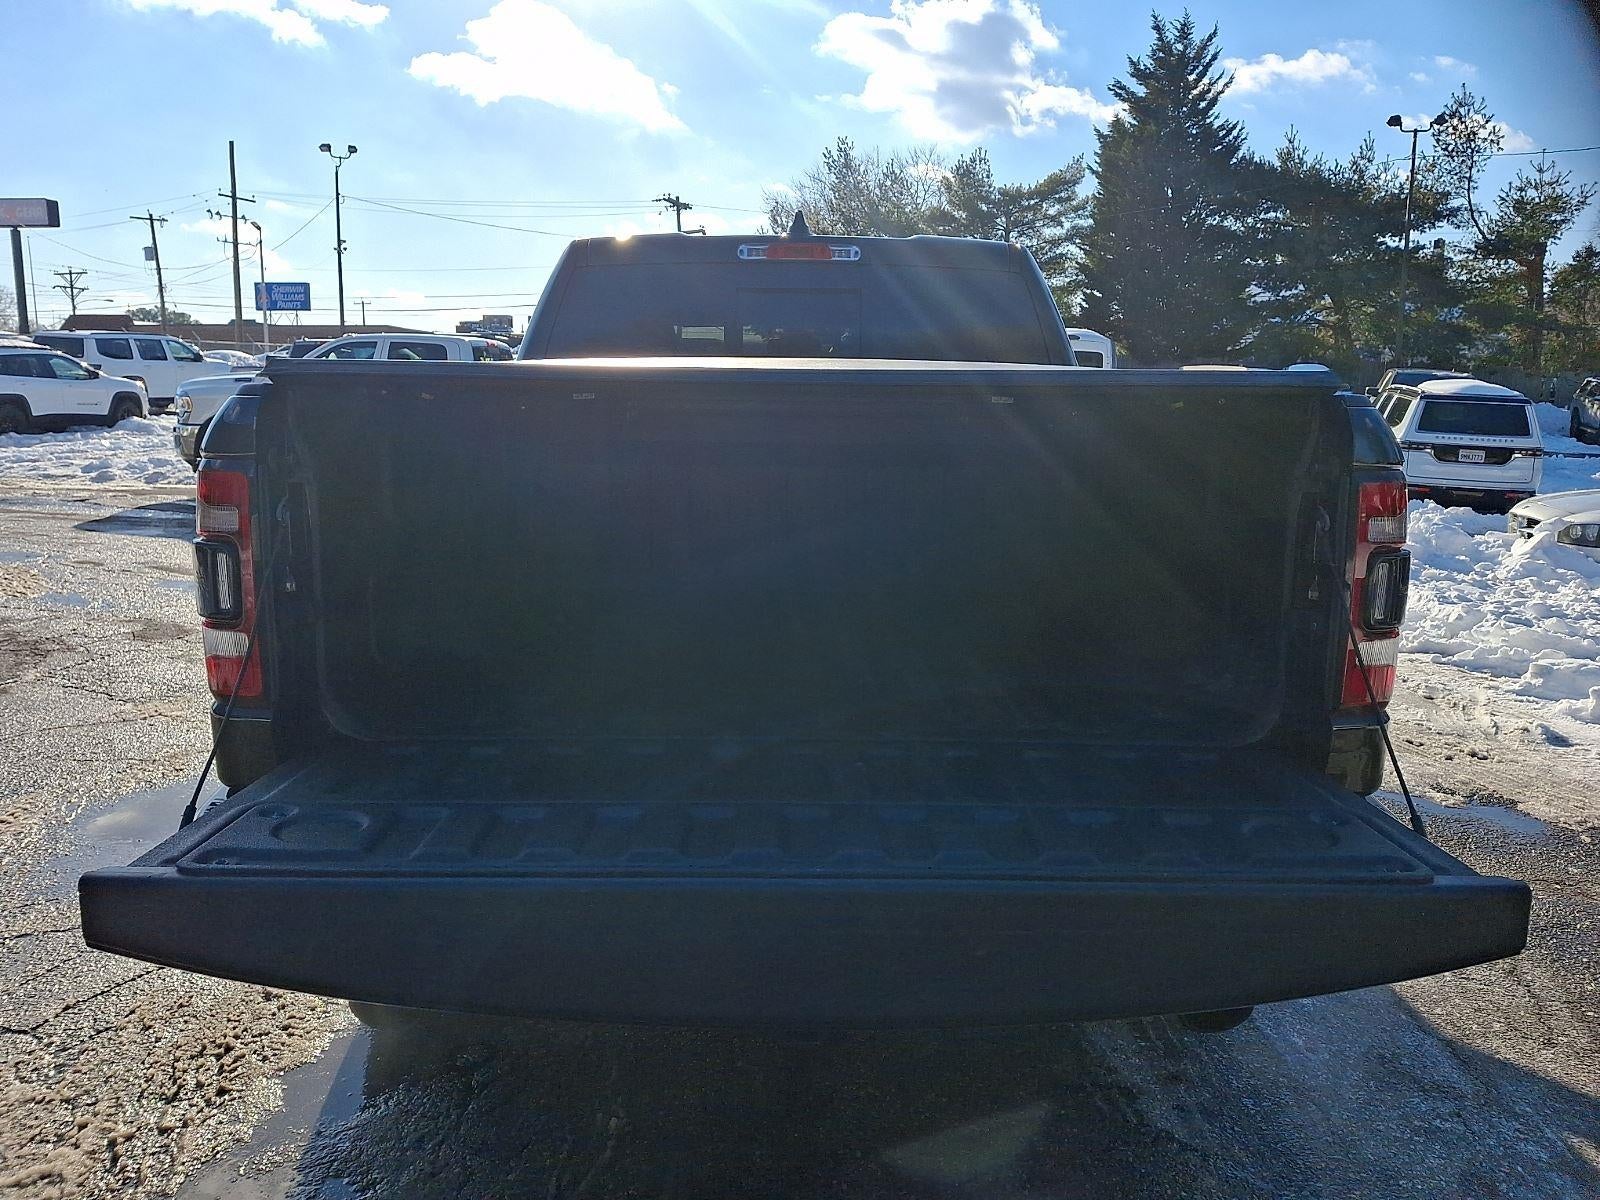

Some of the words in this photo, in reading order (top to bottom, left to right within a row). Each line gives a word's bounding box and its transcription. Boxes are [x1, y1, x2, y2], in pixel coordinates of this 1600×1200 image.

[272, 285, 304, 293] SHERWIN
[271, 293, 305, 301] WILLIAMS
[277, 301, 302, 309] PAINTS
